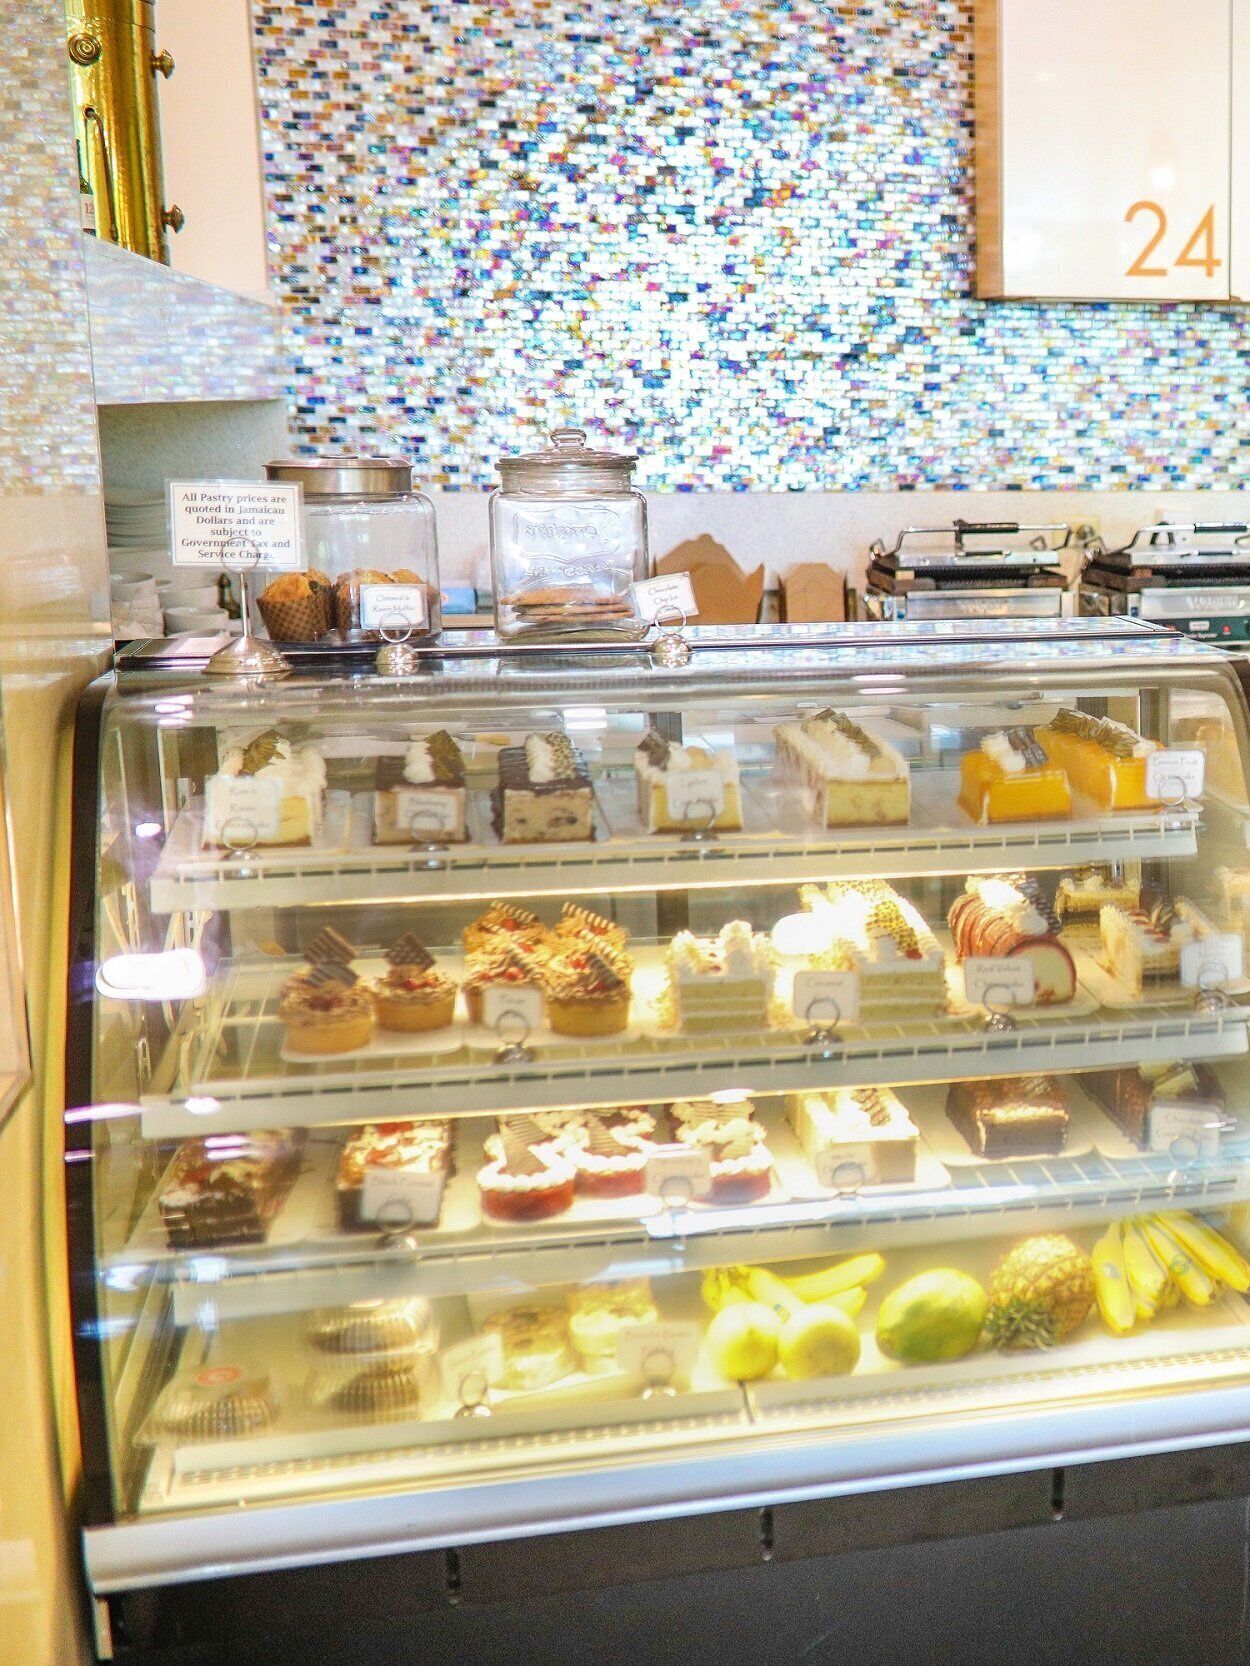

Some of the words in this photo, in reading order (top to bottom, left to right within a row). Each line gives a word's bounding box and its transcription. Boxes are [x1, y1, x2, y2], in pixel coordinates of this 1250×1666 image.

[1124, 200, 1222, 278] 24
[182, 493, 197, 502] All
[200, 494, 233, 504] Pastry
[236, 494, 268, 504] prices
[270, 496, 287, 504] are
[185, 505, 221, 514] quoted
[224, 505, 235, 513] in
[238, 505, 286, 515] Jamaican
[196, 516, 233, 525] Dollars
[236, 516, 256, 525] and
[210, 527, 248, 538] subject
[251, 528, 262, 536] to
[181, 538, 246, 547] Government
[250, 539, 268, 547] Tax
[271, 539, 290, 548] and
[197, 549, 236, 559] Service
